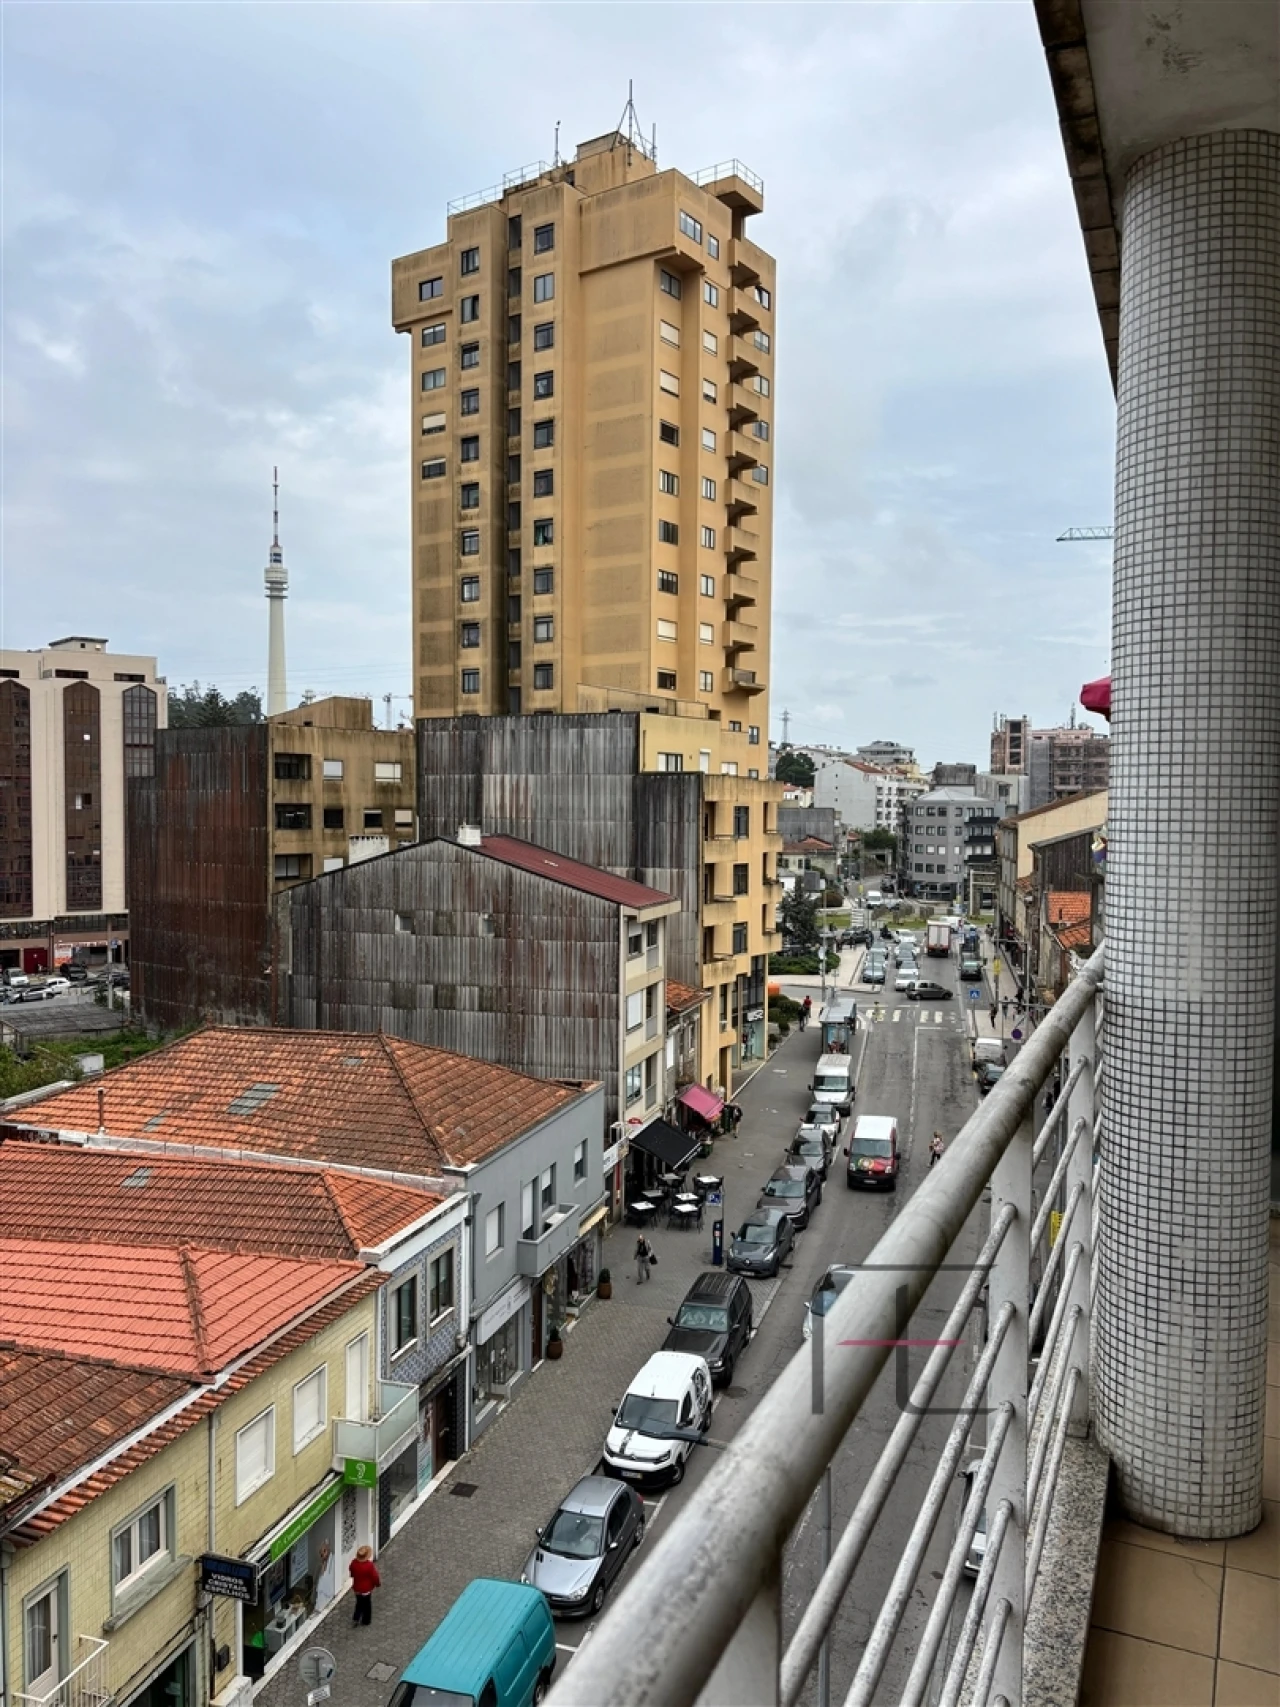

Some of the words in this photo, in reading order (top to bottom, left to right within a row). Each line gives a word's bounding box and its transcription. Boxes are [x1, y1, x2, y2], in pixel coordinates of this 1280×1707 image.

[211, 1572, 244, 1585] VIDROS
[205, 1584, 250, 1599] ESPELHOS
[208, 1579, 247, 1592] CRISTAIS
